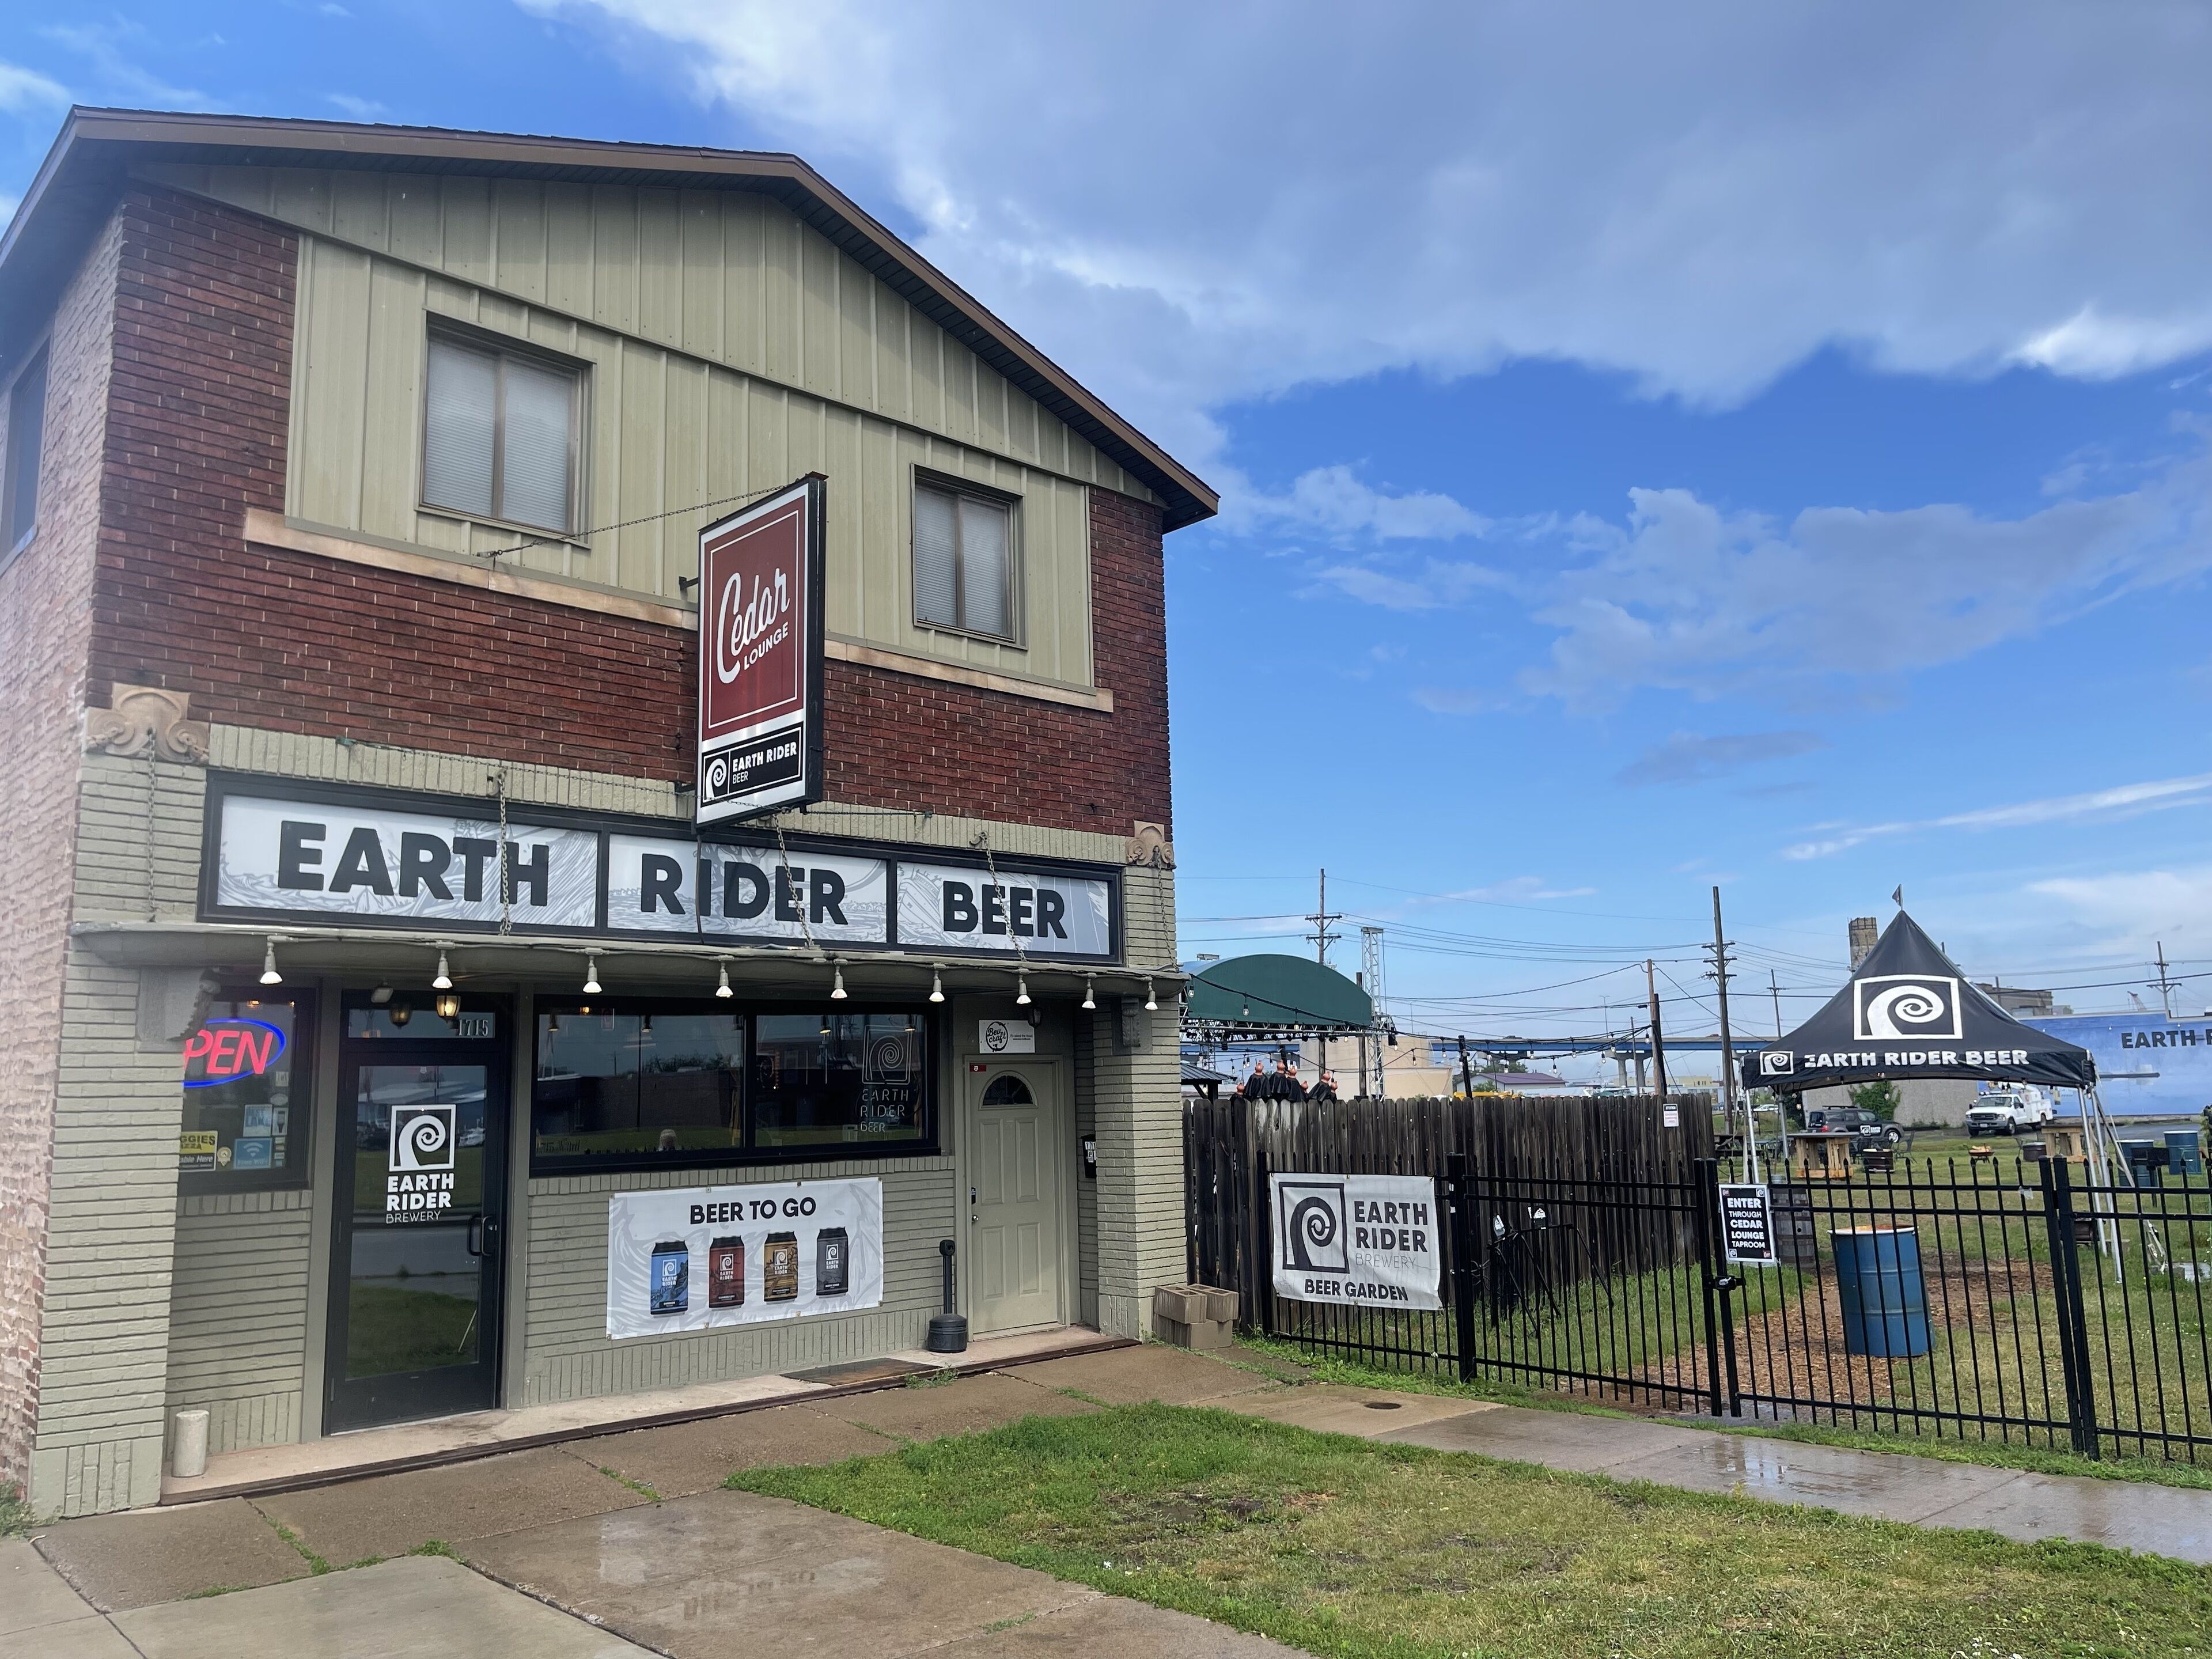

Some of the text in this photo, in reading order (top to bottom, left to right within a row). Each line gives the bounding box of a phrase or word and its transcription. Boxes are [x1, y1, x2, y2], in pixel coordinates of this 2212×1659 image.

[717, 567, 791, 684] Cedar
[743, 621, 789, 671] LOUNGE
[732, 741, 797, 772] EARTH RIDER
[732, 770, 748, 784] BEER
[278, 820, 1068, 940] EARTH RIDER BEER
[459, 1019, 488, 1036] 1715
[988, 1031, 1006, 1043] craft
[2121, 1029, 2196, 1049] EARTH
[183, 1029, 274, 1075] PEN
[1804, 1050, 2029, 1068] EARTH RIDER BEER
[862, 1089, 909, 1102] EARTH
[860, 1104, 906, 1118] RIDER
[860, 1122, 885, 1133] BEER
[180, 1135, 215, 1146] GGIES
[387, 1173, 454, 1193] EARTH
[386, 1192, 452, 1211] RIDER
[690, 1196, 816, 1225] BEER TO GO
[1727, 1198, 1762, 1209] ENTER
[385, 1210, 441, 1224] BREWERY
[1354, 1200, 1428, 1226] EARTH
[1730, 1219, 1763, 1229] CEDAR
[1355, 1227, 1428, 1252] RIDER
[1731, 1231, 1764, 1240] LOUNGE
[1355, 1253, 1416, 1269] BREWERY
[1304, 1279, 1409, 1301] BEER GARDEN
